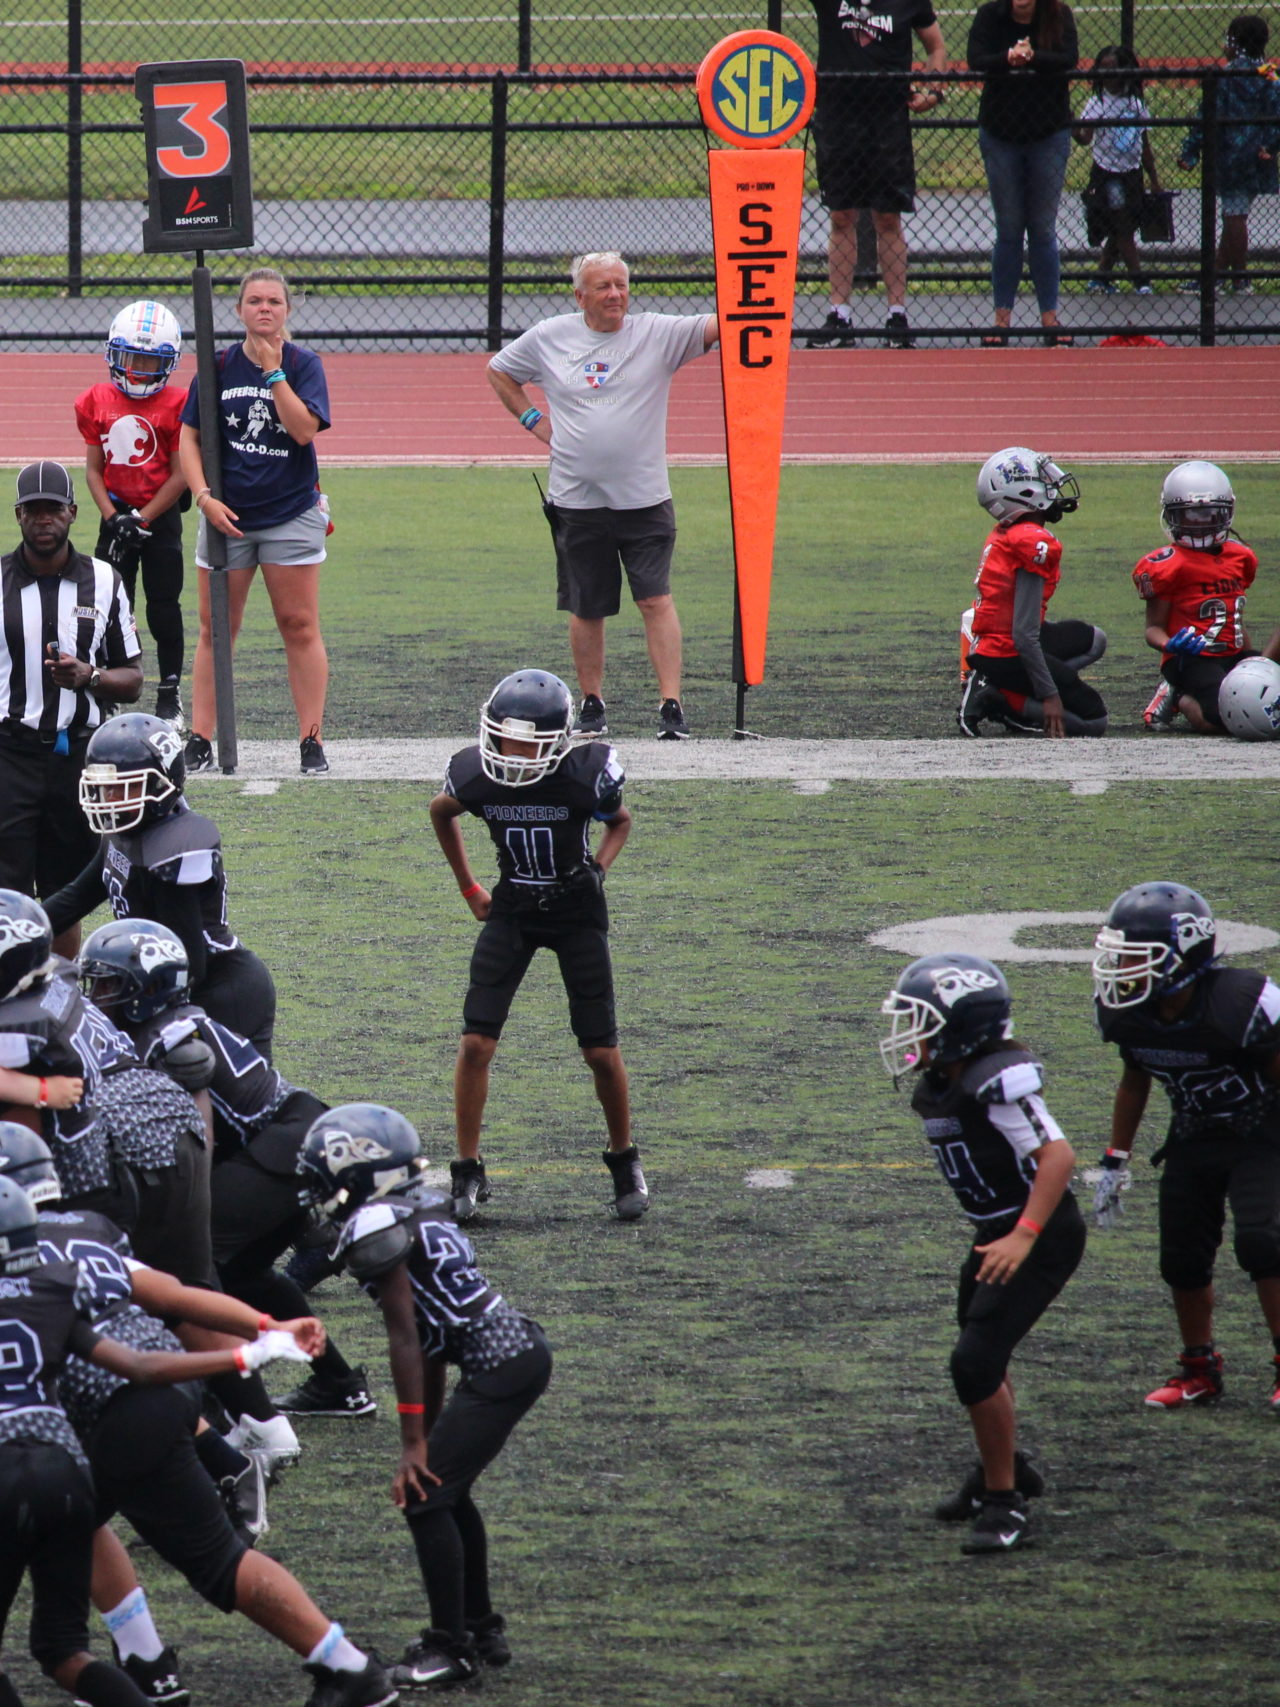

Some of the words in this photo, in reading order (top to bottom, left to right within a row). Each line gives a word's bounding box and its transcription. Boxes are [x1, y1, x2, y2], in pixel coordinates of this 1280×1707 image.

[718, 48, 799, 133] SEC
[153, 80, 231, 178] 3
[175, 218, 192, 226] BSN
[193, 215, 219, 225] SPORTS
[1033, 541, 1049, 565] 3
[483, 805, 569, 821] PIONEERS
[506, 827, 557, 878] 11
